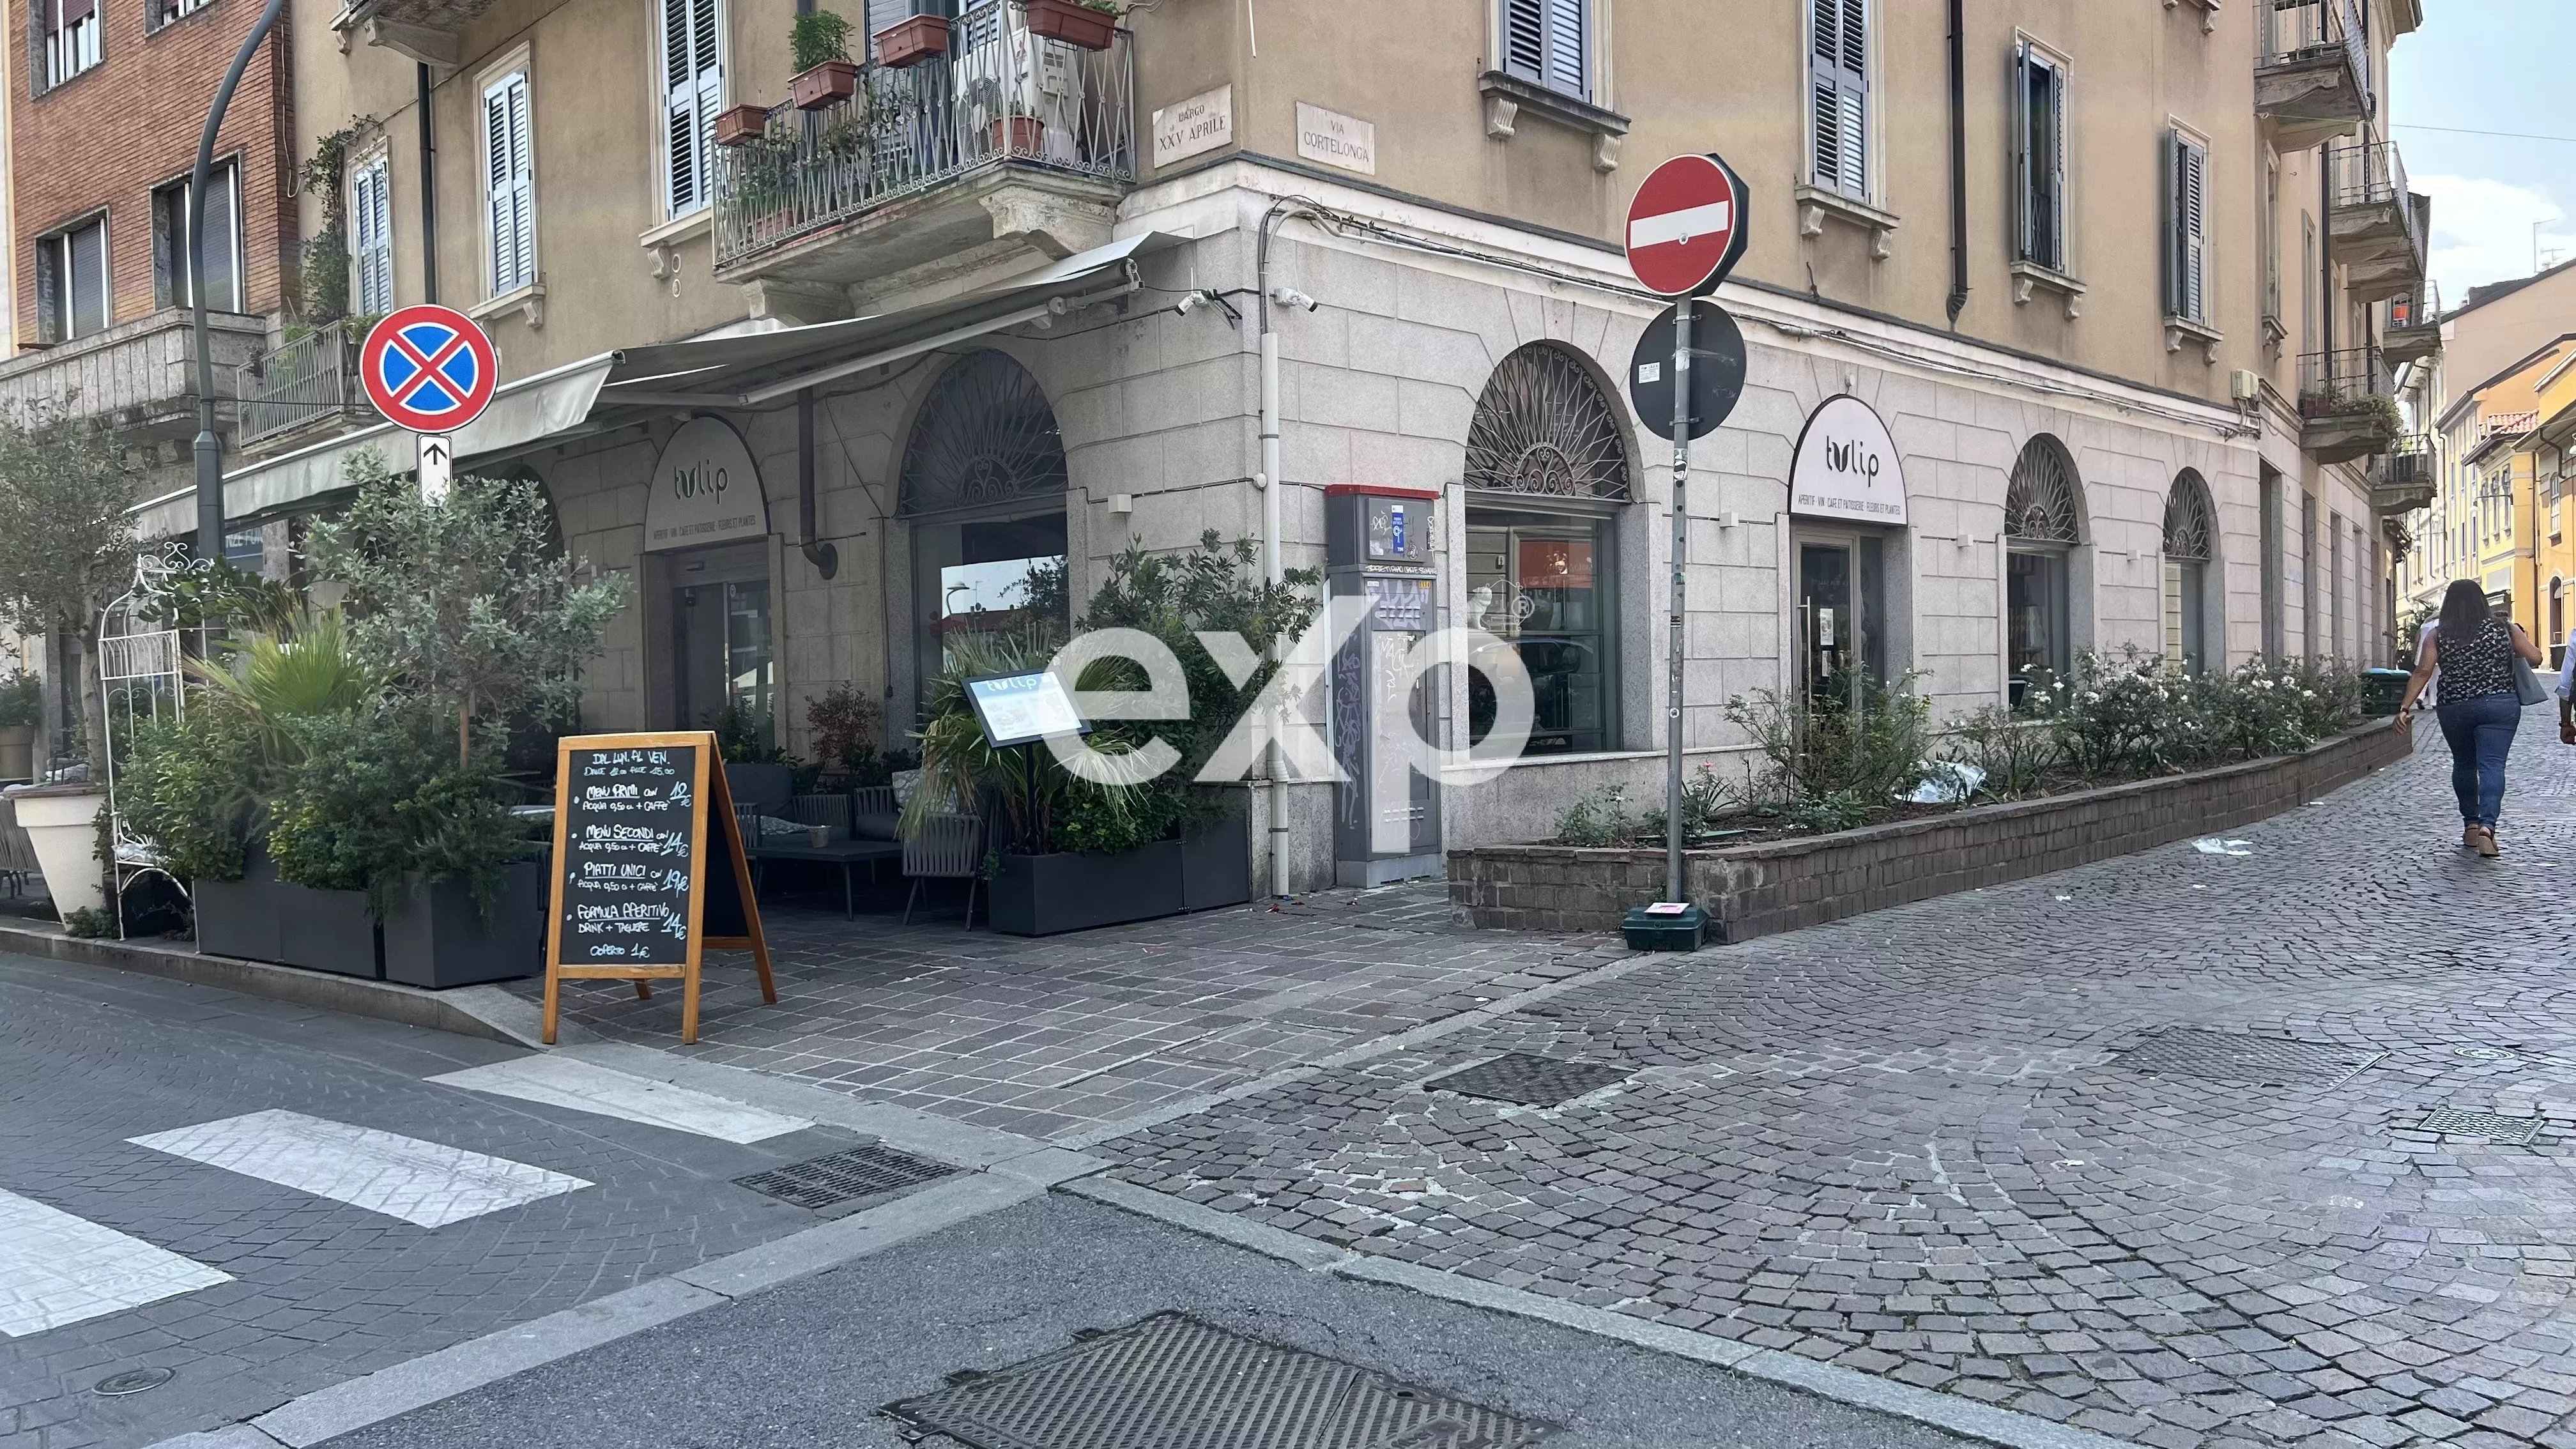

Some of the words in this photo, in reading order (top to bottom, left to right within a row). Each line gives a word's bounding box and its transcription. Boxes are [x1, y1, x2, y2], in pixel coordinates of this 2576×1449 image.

[1179, 105, 1204, 123] LARGO
[1160, 130, 1183, 152] XXV
[1189, 116, 1225, 142] APRILE
[1330, 120, 1344, 134] VIA
[1304, 132, 1369, 162] CORTELONGA
[1826, 435, 1879, 487] tulip
[674, 459, 728, 504] tulip
[986, 676, 1037, 691] tulip
[631, 750, 643, 762] AL
[648, 750, 670, 765] VEN.
[584, 861, 617, 876] PIATTI
[621, 863, 647, 877] UNICI
[578, 904, 619, 919] FORMULA
[623, 902, 670, 917] APERITIVO
